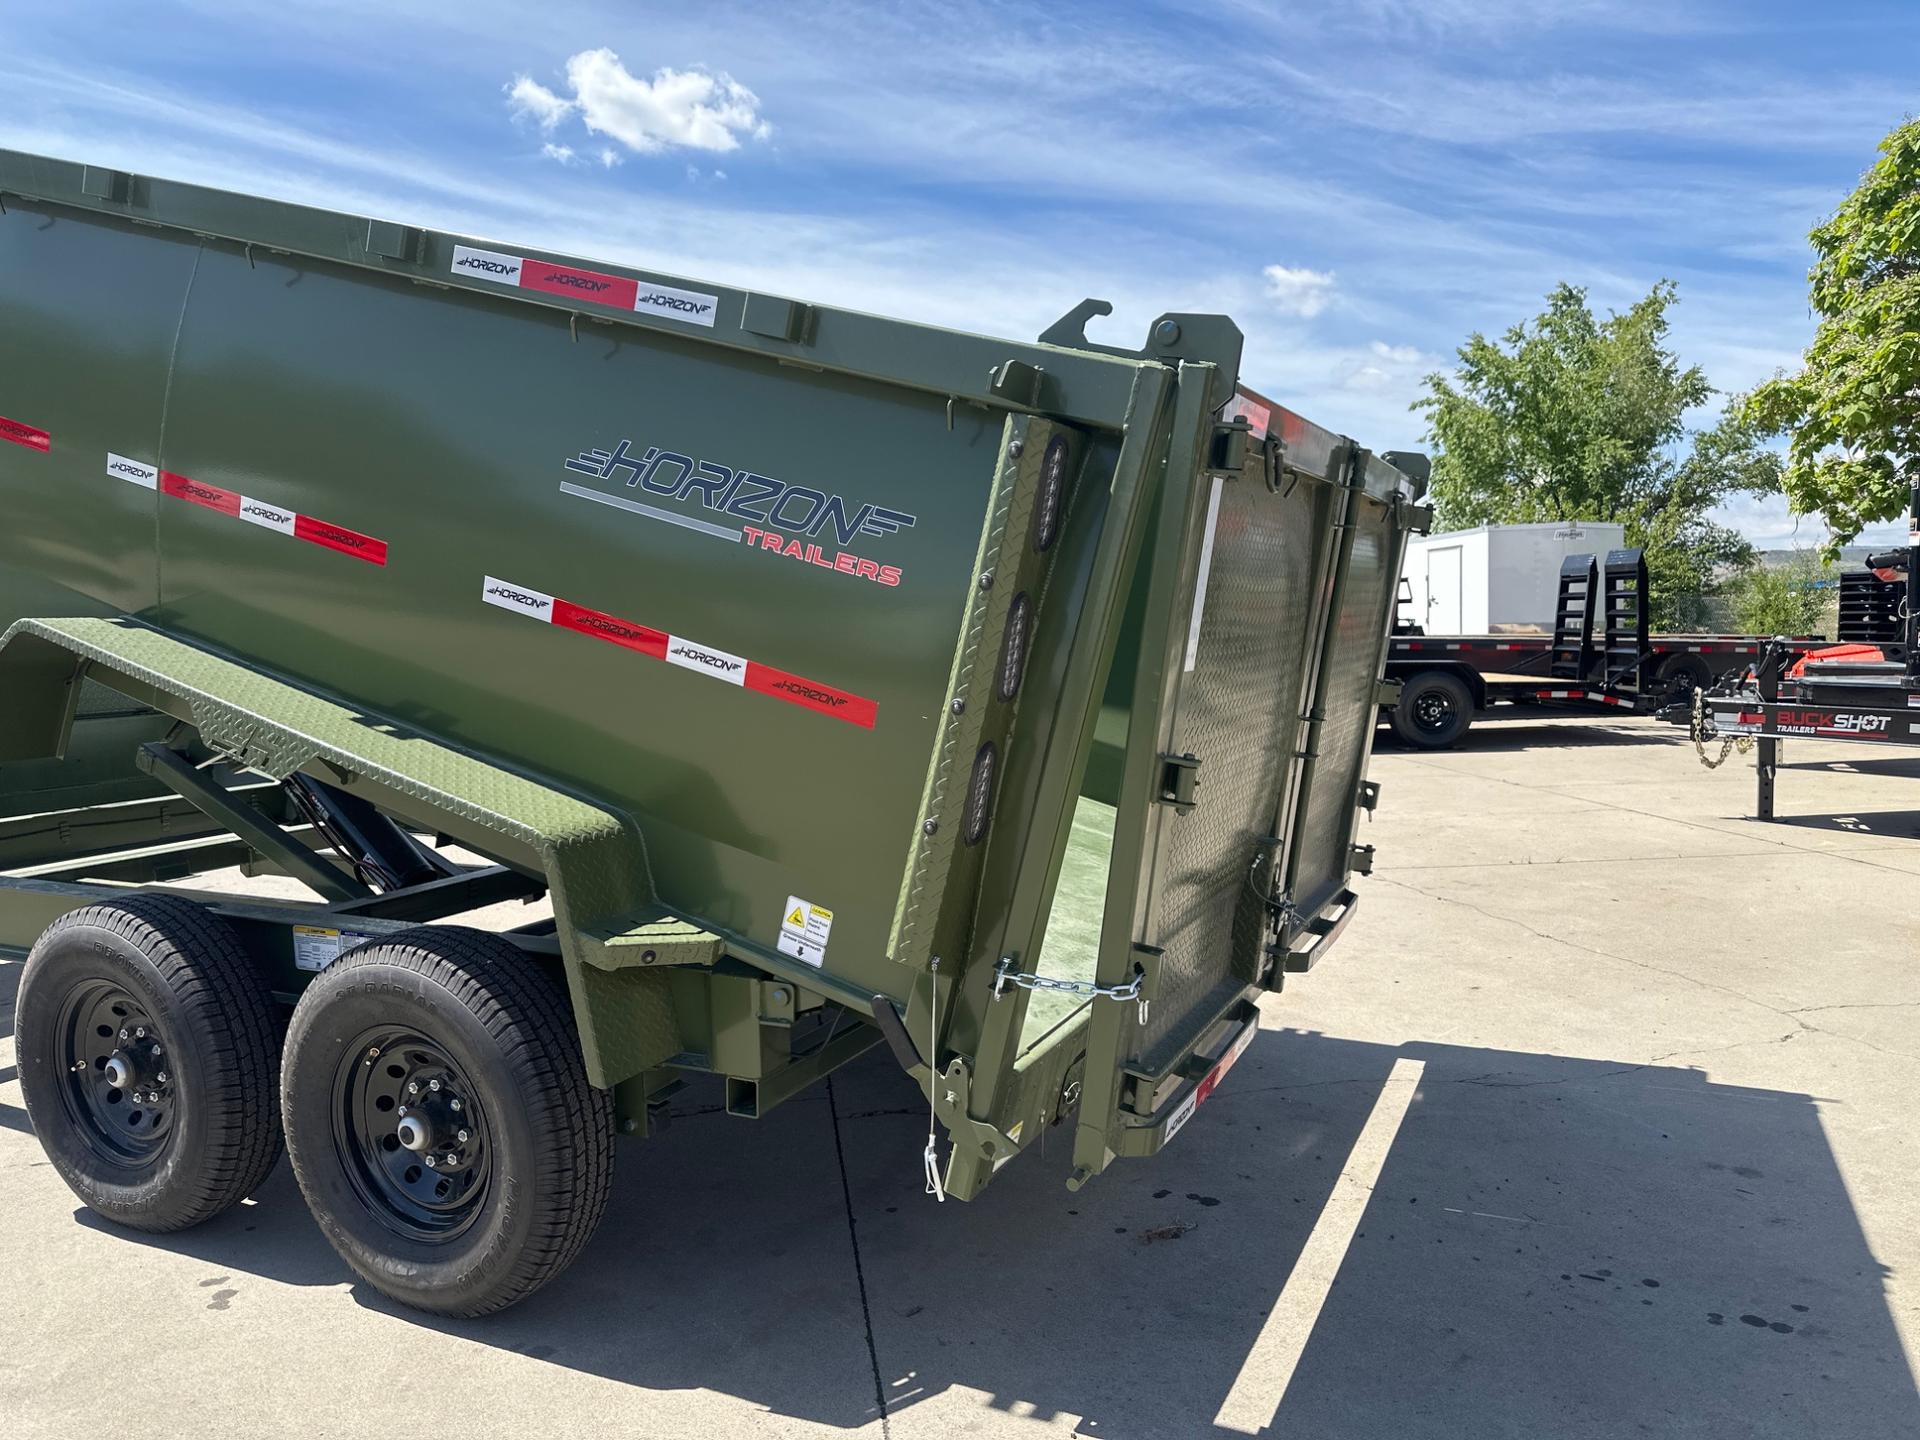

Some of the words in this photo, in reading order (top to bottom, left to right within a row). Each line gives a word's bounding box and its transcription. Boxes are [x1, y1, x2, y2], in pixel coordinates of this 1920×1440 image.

[462, 257, 513, 276] HORIZON
[550, 272, 604, 292] HORIZON
[647, 293, 703, 314] HORIZON
[114, 461, 150, 480] HORIZON
[182, 484, 218, 501] HORIZON
[247, 504, 288, 526] HORIZON
[599, 439, 875, 546] HORIZON
[743, 525, 903, 587] TRAILERS
[494, 586, 543, 609] HORIZON
[584, 615, 637, 639] HORIZON
[678, 646, 736, 673] HORIZON
[779, 679, 841, 708] HORIZON
[1776, 725, 1816, 734] TRAILERS
